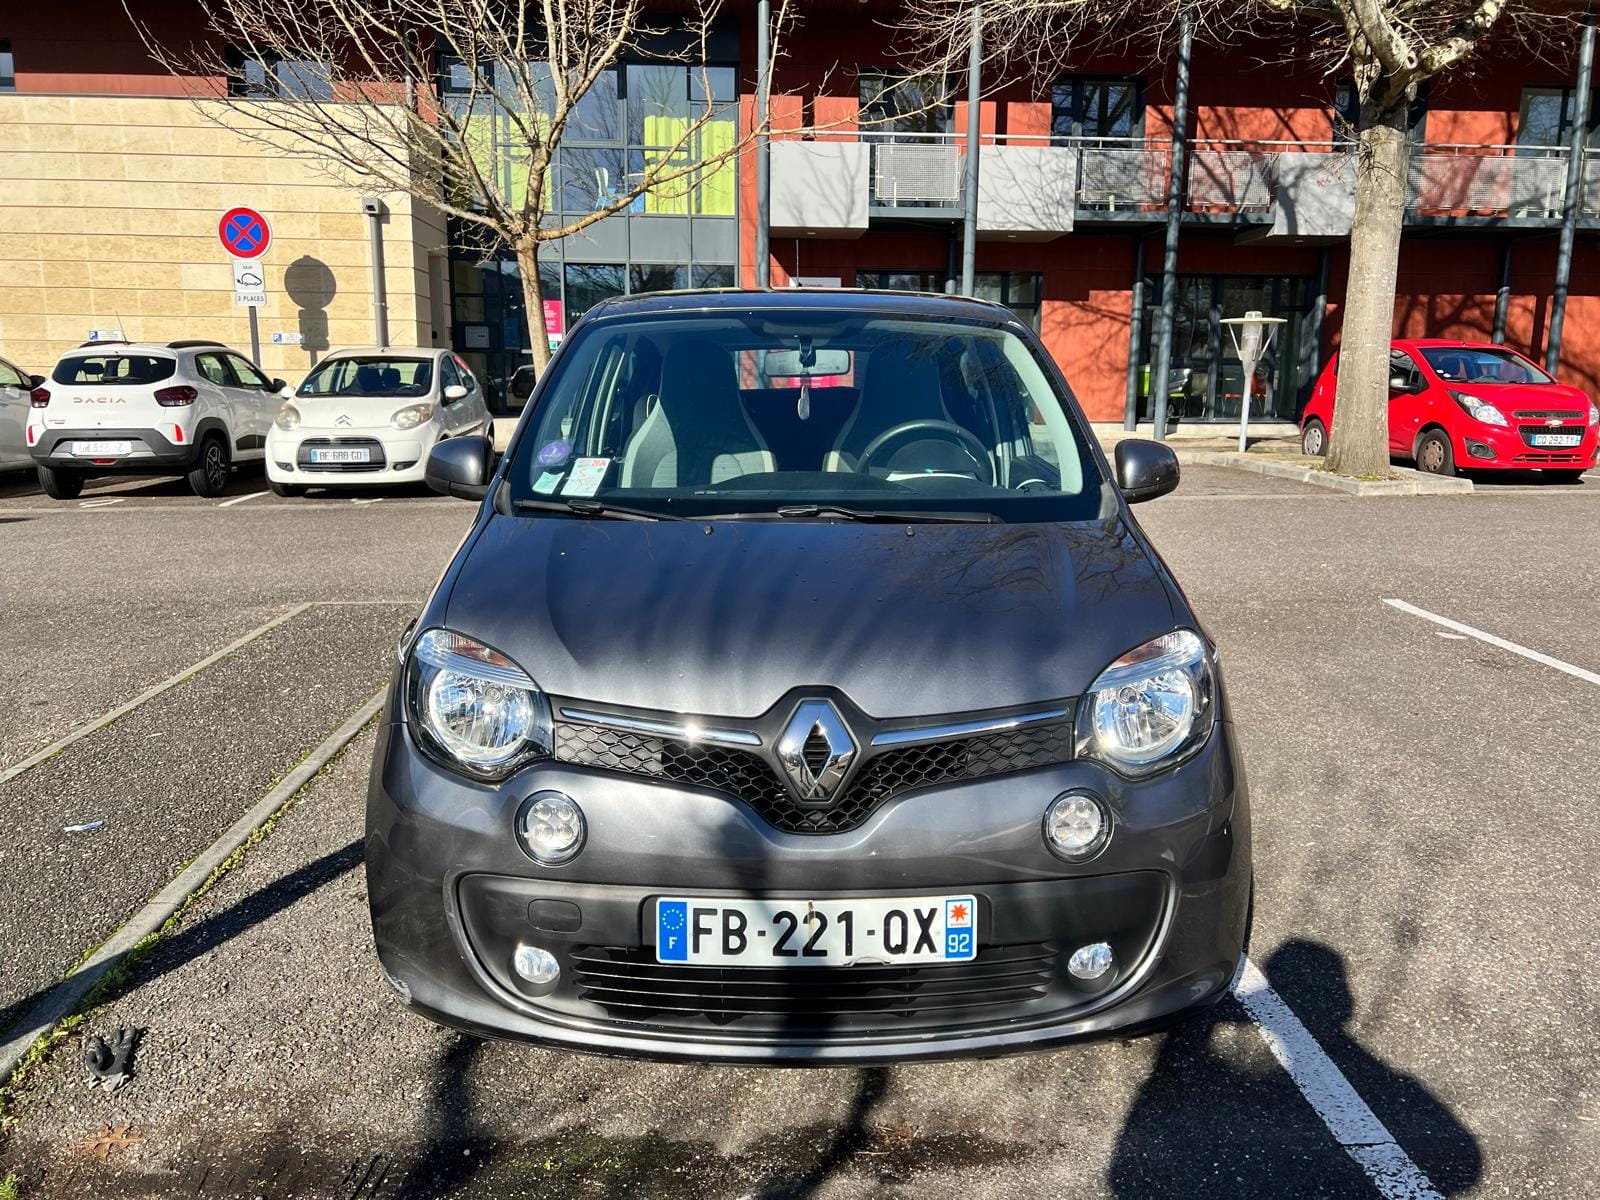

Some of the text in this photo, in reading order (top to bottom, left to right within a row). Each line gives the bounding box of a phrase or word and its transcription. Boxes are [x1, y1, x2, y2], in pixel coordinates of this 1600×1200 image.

[72, 396, 127, 404] DACIA
[669, 936, 677, 949] F
[948, 933, 970, 953] 92
